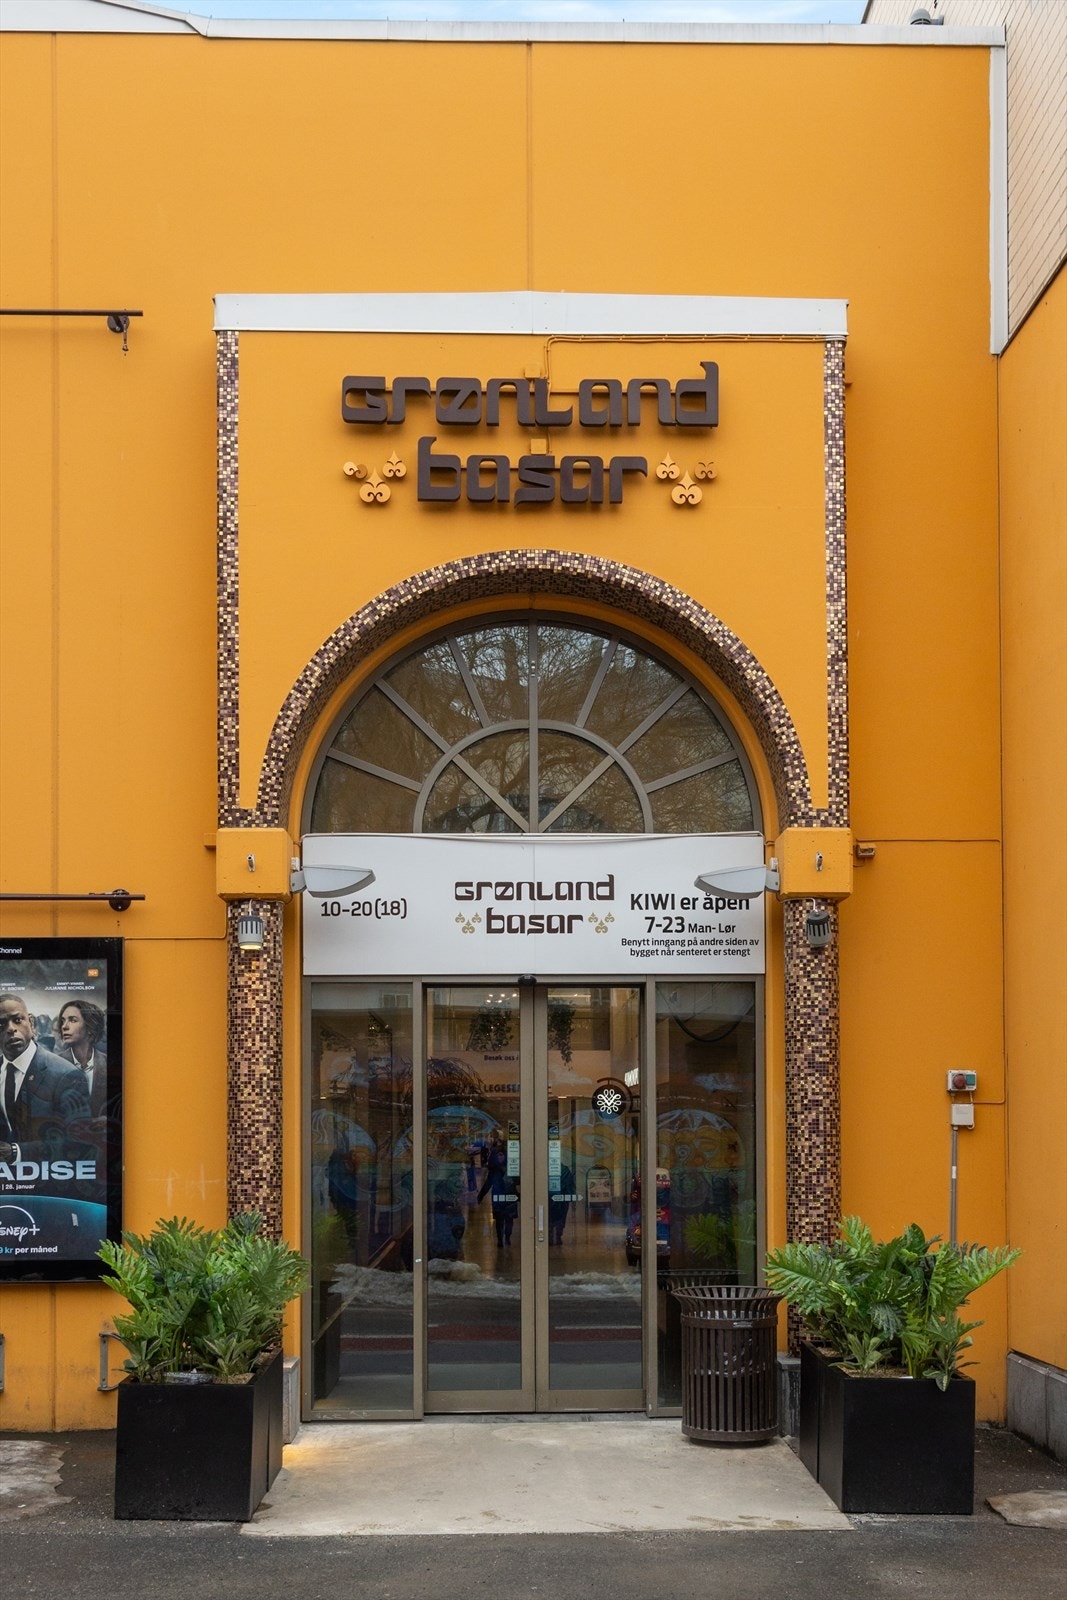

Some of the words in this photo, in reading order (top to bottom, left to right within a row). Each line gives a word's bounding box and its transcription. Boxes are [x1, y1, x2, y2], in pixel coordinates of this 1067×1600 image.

[416, 435, 649, 509] basar
[630, 893, 675, 911] KIWI
[680, 897, 699, 911] er
[703, 892, 750, 913] åpen
[486, 906, 584, 936] basar
[644, 916, 686, 934] 7-23
[688, 923, 717, 934] Man-
[718, 923, 736, 934] Lør
[621, 938, 650, 947] Benytt
[651, 938, 686, 948] inngang
[687, 937, 698, 947] på
[699, 938, 725, 946] andre
[725, 938, 749, 946] siden
[630, 948, 659, 957] bygget
[660, 946, 675, 956] når
[676, 948, 712, 956] senteret
[723, 948, 751, 957] stengt
[14, 1247, 29, 1255] per
[30, 1245, 58, 1253] måned
